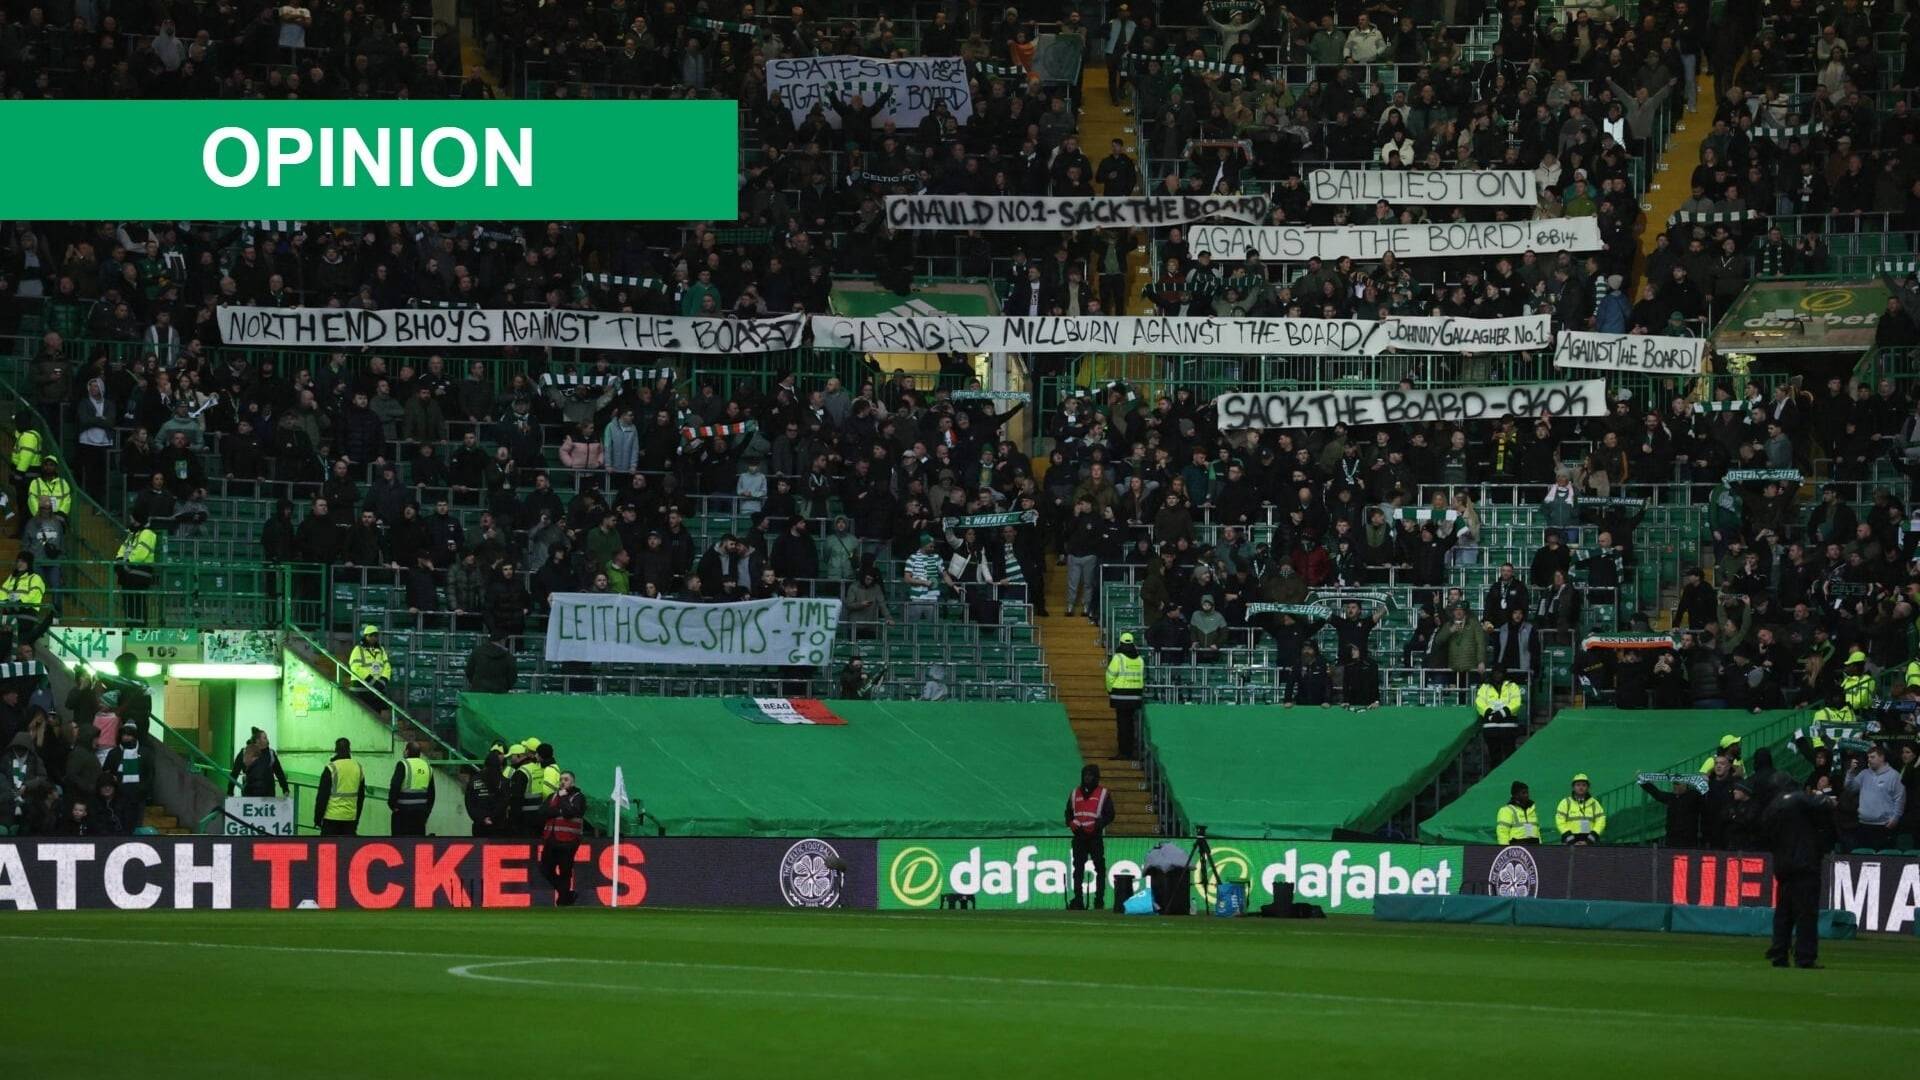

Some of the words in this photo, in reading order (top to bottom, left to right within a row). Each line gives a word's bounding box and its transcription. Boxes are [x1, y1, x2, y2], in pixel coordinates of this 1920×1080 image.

[775, 59, 930, 80] SPATESTON
[907, 85, 969, 111] BOARD
[862, 171, 899, 182] CELTIC
[1315, 171, 1526, 200] BAILLIESTON
[889, 198, 994, 227] CNAULD
[1183, 195, 1267, 220] BOARD
[1194, 226, 1338, 257] AGAINST
[1348, 228, 1410, 254] THE
[1428, 222, 1532, 252] BOARD!
[229, 311, 315, 342] NORTH
[322, 310, 387, 343] END
[394, 310, 491, 342] BHOYS
[503, 310, 600, 343] AGAINST
[605, 317, 681, 348] THE
[691, 319, 801, 353] BOARD
[832, 318, 990, 351] GARNGAD
[1003, 317, 1120, 346] MILLBURN
[1132, 317, 1228, 346] AGAINST
[1234, 319, 1281, 345] THE
[1285, 321, 1380, 355] BOARD!
[1387, 319, 1442, 346] JOHNNY
[1440, 318, 1511, 347] GALLAGHER
[1556, 331, 1613, 362] AGAINST
[1225, 394, 1310, 429] SACK
[1308, 393, 1375, 427] THE
[973, 514, 1009, 525] HATATE
[558, 604, 631, 645] LEITH
[782, 601, 837, 631] TIME
[791, 630, 826, 647] TO
[242, 803, 276, 817] Exit
[272, 821, 292, 835] 14
[1262, 848, 1452, 908] dafabet
